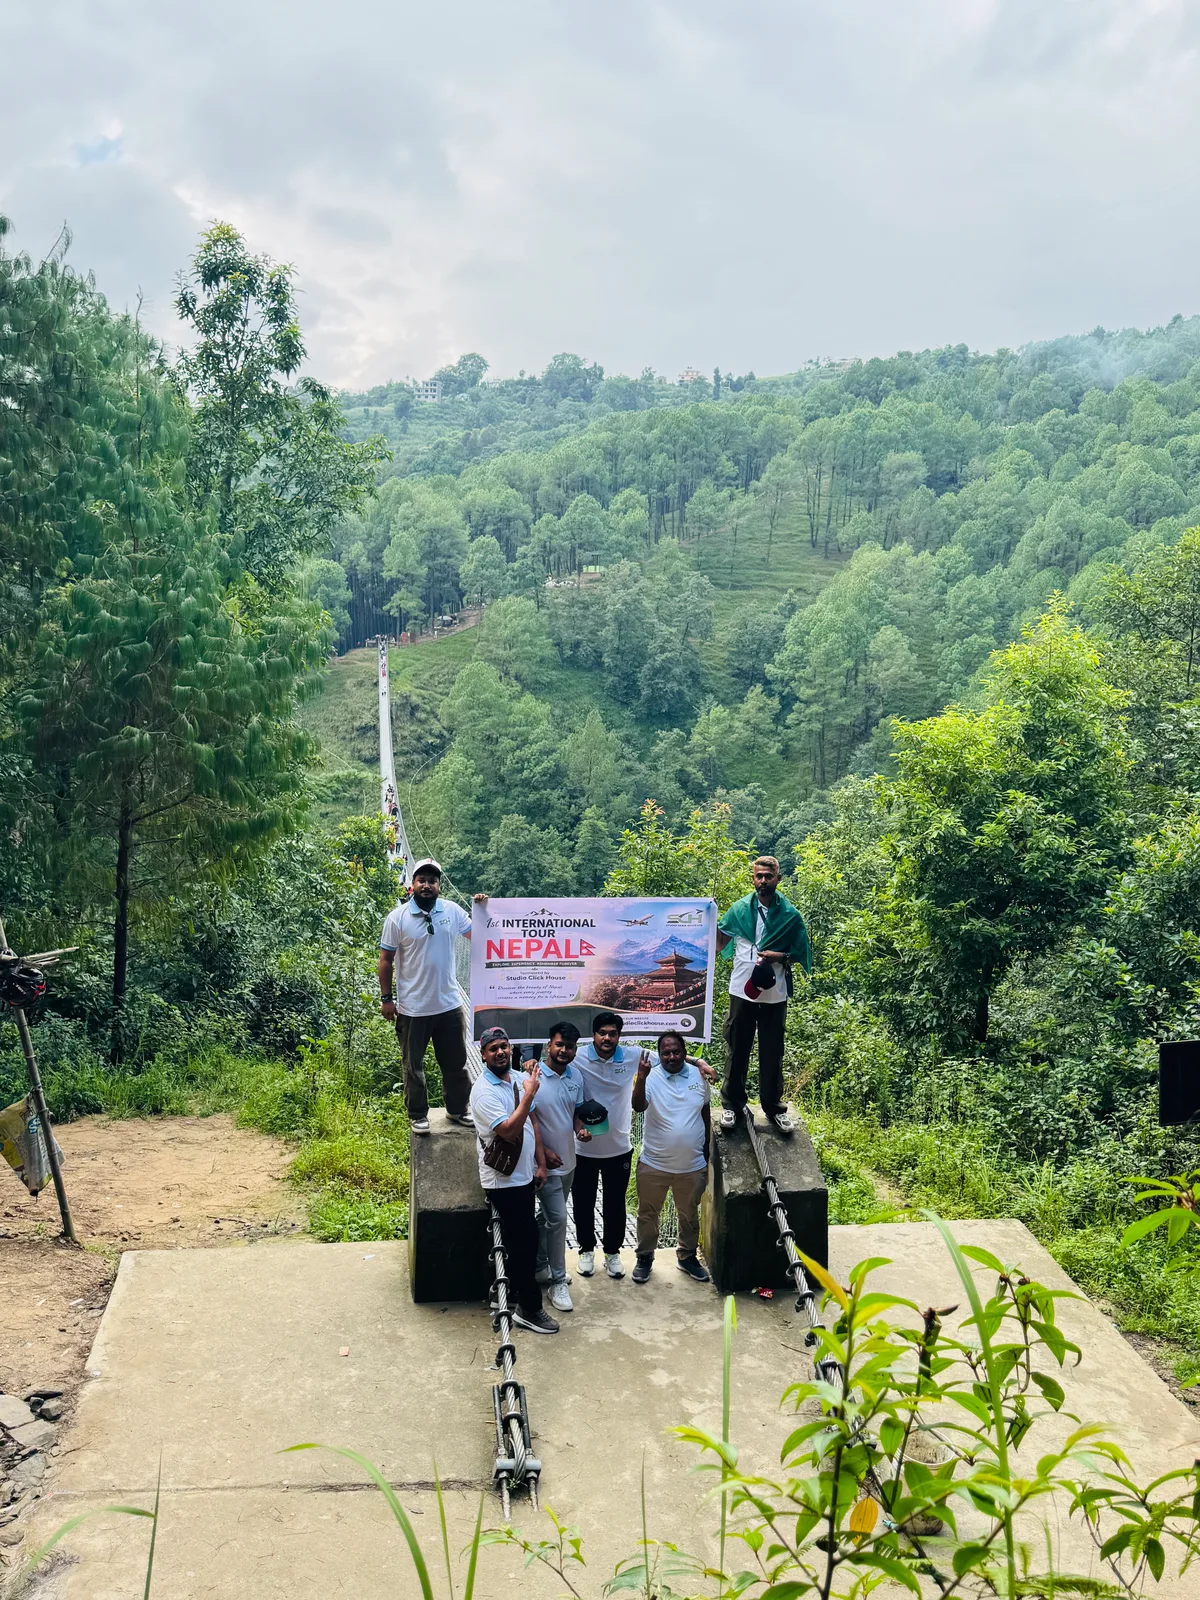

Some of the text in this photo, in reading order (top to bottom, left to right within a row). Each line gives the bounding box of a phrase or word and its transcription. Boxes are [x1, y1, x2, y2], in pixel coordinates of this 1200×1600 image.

[486, 917, 596, 928] 1st INTERNATIONAL
[521, 929, 556, 938] TOUR
[486, 939, 579, 960] NEPAL
